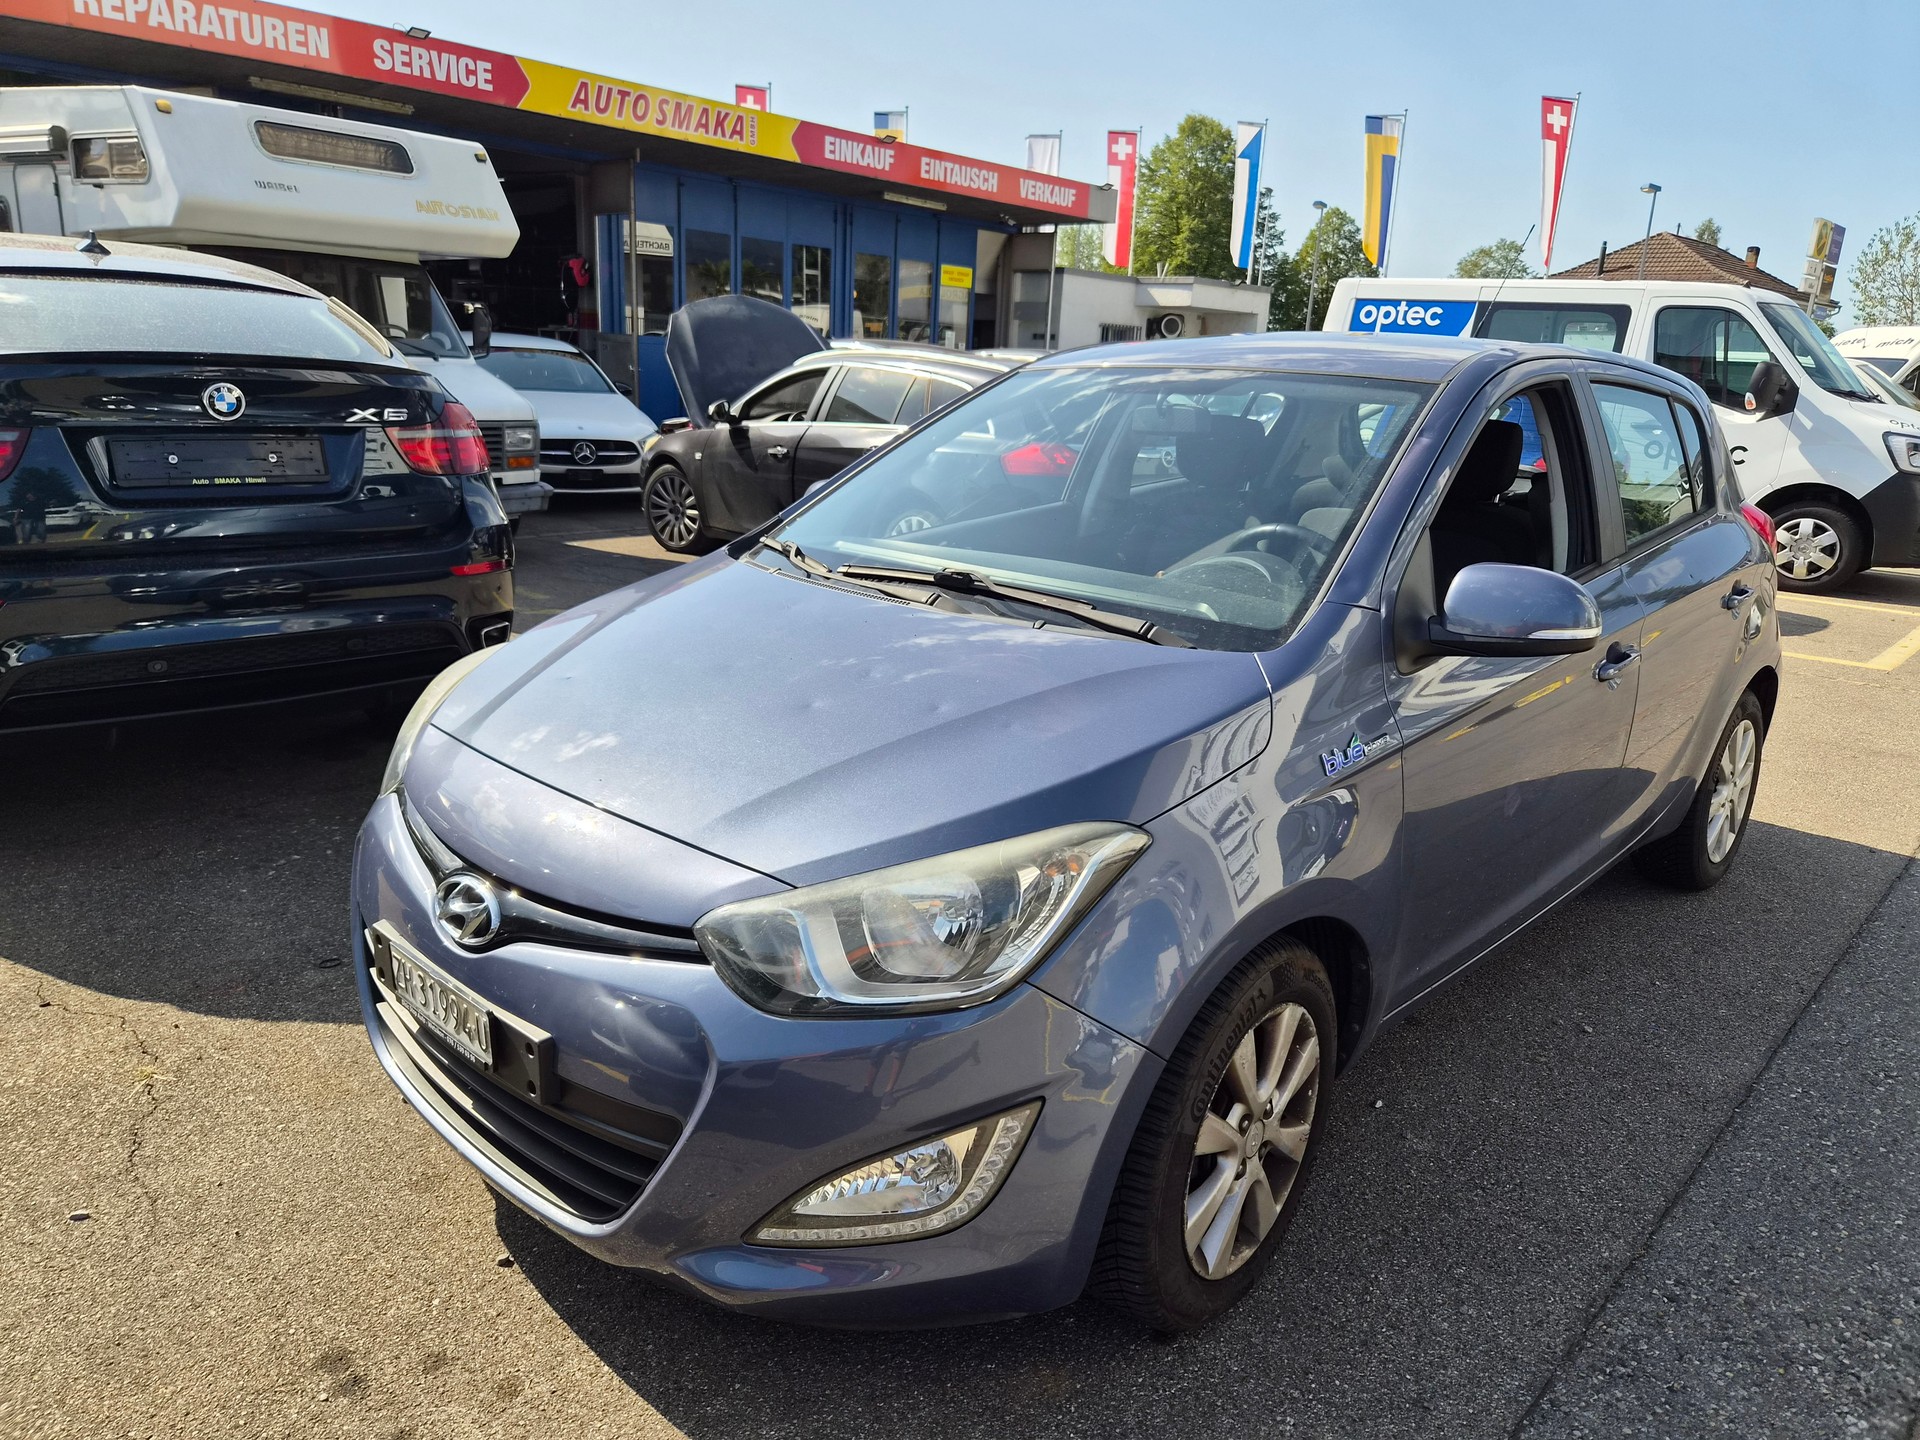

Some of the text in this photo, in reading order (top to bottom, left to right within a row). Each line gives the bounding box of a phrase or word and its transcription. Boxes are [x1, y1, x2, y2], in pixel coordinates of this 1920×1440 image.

[373, 38, 494, 92] SERVICE
[570, 80, 651, 123] AUTO
[655, 97, 745, 143] SMAKA
[824, 135, 895, 171] EINKAUF
[920, 156, 998, 193] EINTAUSCH
[1019, 178, 1077, 208] VERKAUF
[1359, 301, 1444, 333] optec
[1876, 337, 1915, 349] mich
[345, 408, 409, 423] X6
[214, 476, 241, 485] SMAKA
[1191, 994, 1258, 1124] Continental
